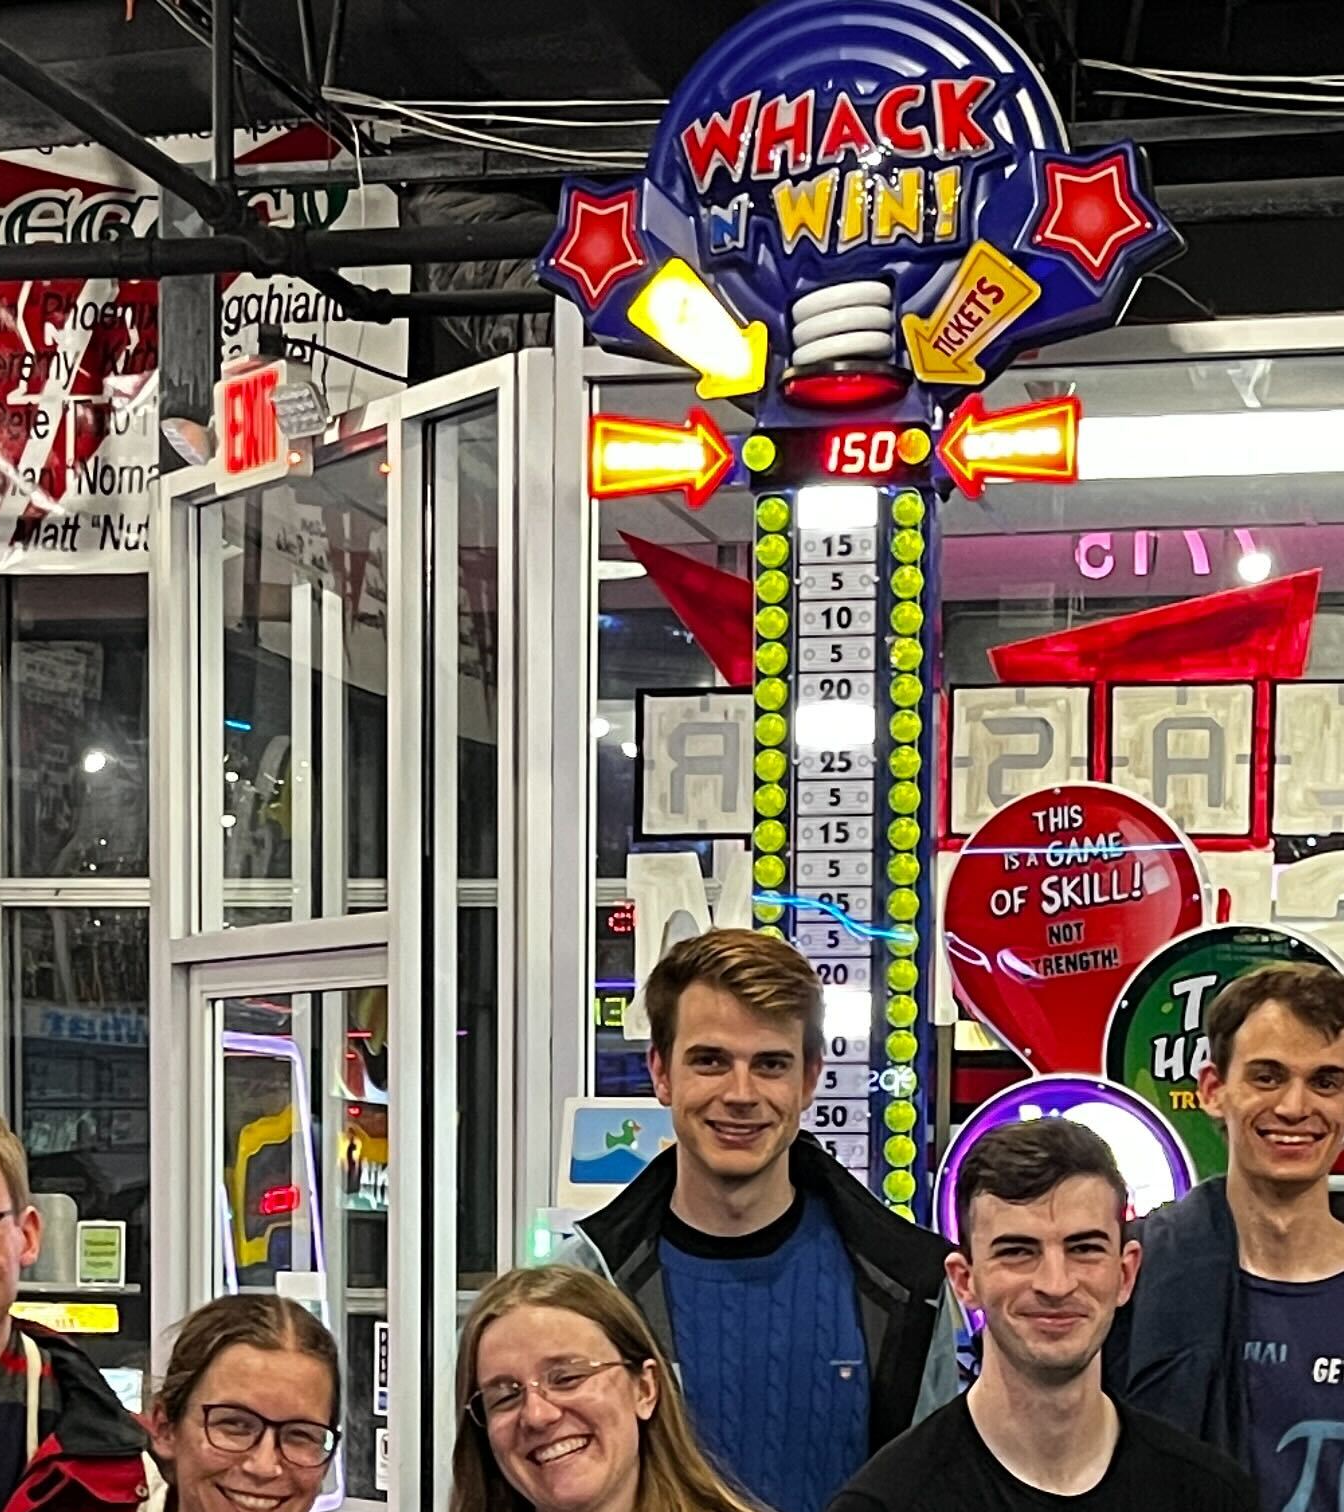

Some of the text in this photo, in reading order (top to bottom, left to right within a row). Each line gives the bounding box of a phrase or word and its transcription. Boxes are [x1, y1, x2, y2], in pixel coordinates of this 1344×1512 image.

[682, 75, 997, 192] WHACK
[772, 166, 961, 253] WIN!
[224, 284, 347, 337] gghiant
[932, 275, 1005, 358] TICKETS
[225, 369, 280, 475] EXIT
[827, 431, 895, 473] 150
[11, 514, 81, 552] Matt
[822, 537, 853, 557] 15
[830, 572, 844, 592] 5
[821, 607, 853, 628] 10
[830, 645, 843, 664] 5
[819, 679, 852, 701] 20
[819, 751, 853, 773] 25
[829, 786, 842, 806] 5
[1032, 805, 1084, 833] THIS
[819, 822, 851, 843] 15
[1004, 831, 1124, 871] IS A GAME
[828, 859, 841, 878] 5
[991, 861, 1144, 916] OF SKILL!
[826, 929, 840, 949] 5
[1047, 921, 1085, 946] NOT
[817, 963, 849, 985] 20
[1031, 947, 1120, 979] TRENGTH!
[824, 1071, 838, 1089] 5
[815, 1105, 848, 1127] 50
